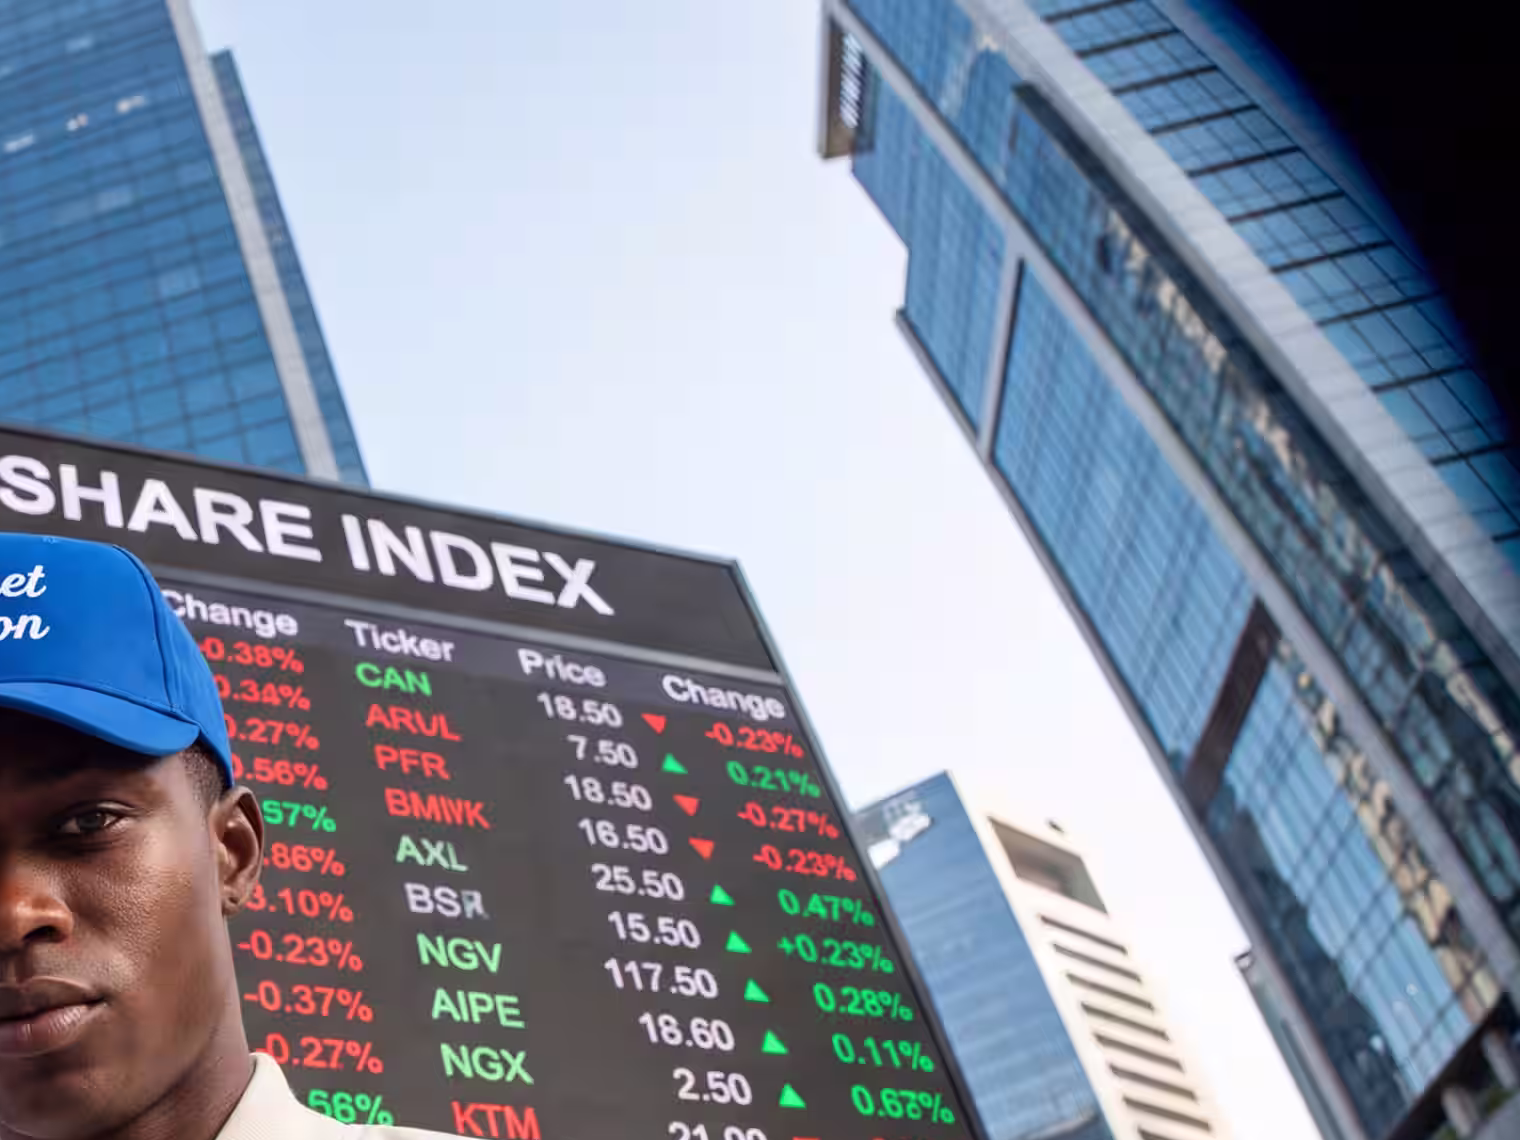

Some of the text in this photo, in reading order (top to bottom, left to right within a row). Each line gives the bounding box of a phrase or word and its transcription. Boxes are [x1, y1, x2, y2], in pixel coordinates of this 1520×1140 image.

[341, 513, 614, 615] INDEX
[162, 591, 299, 638] Change
[344, 620, 786, 720] Ticker Price Change
[356, 663, 432, 695] CAN
[366, 704, 821, 798] ARUL 7.50 0.21%
[374, 744, 450, 780] PFR
[565, 775, 652, 810] 18.50
[397, 836, 874, 925] AXL 25.50 0.47%
[238, 930, 362, 971] -0.23%
[608, 912, 700, 948] 15.50
[778, 934, 894, 972] +0.23%
[244, 980, 372, 1022] -0.37%
[417, 934, 912, 1020] NGV 117.50 0.28%
[432, 988, 934, 1072] AIPE 18.60 0.11%
[441, 1044, 533, 1083] NGX
[673, 1068, 752, 1105] 2.50
[452, 1101, 541, 1140] KTM
